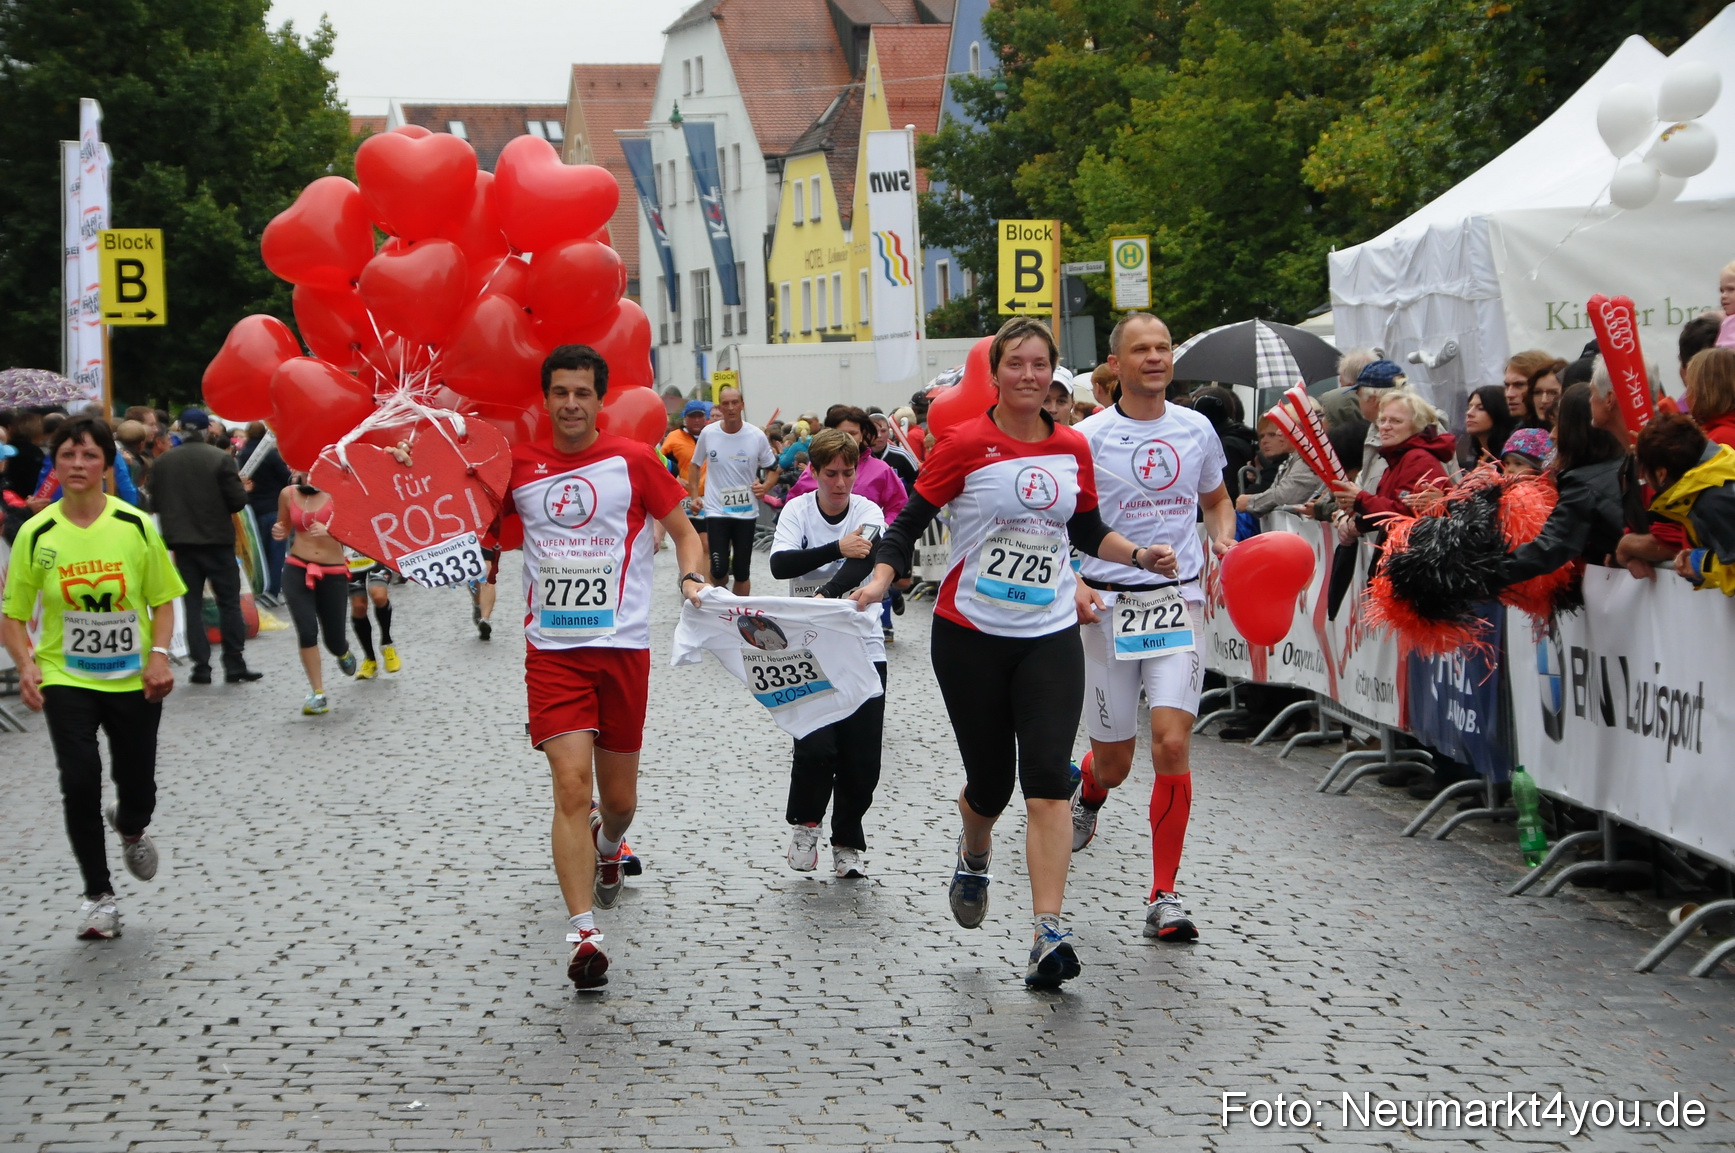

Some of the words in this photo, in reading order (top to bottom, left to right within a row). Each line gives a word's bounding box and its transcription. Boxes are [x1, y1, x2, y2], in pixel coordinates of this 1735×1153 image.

[103, 232, 154, 250] Block
[1006, 223, 1053, 241] Block
[1015, 248, 1045, 293] B
[115, 257, 147, 303] B
[1546, 302, 1655, 330] Kier
[713, 371, 737, 381] Block
[1622, 366, 1645, 409] BKK
[393, 473, 431, 501] für
[723, 492, 750, 506] 2144
[1155, 498, 1172, 506] MIT
[371, 487, 482, 560] ROSI
[995, 516, 1027, 526] LAUFEN
[1029, 517, 1044, 526] MIT
[1045, 518, 1065, 529] HERZ
[1009, 525, 1026, 535] Heck
[532, 538, 566, 547] AUFEN
[569, 537, 588, 547] MIT
[590, 535, 616, 546] HERZ
[985, 537, 1014, 547] PARTL
[1015, 540, 1049, 552] Neumarkt
[398, 555, 427, 569] PARTL
[427, 540, 466, 559] Neumarkt
[58, 560, 123, 580] Müller
[412, 549, 482, 588] 3333
[539, 567, 560, 575] PARTL
[561, 566, 601, 575] Neumarkt
[986, 547, 1053, 584] 2725
[544, 577, 607, 607] 2723
[1007, 587, 1027, 601] Eva
[1115, 598, 1142, 607] PARTL
[1141, 593, 1175, 609] Neumarkt
[64, 616, 90, 626] PARTL
[551, 614, 599, 626] Johannes
[1121, 603, 1185, 633] 2722
[70, 627, 133, 654] 2349
[1142, 636, 1166, 649] Knut
[77, 659, 127, 670] Rosmarie
[743, 654, 767, 663] PARTL
[767, 653, 802, 663] Neumarkt
[751, 661, 818, 691] 3333
[1095, 686, 1111, 730] 2XU
